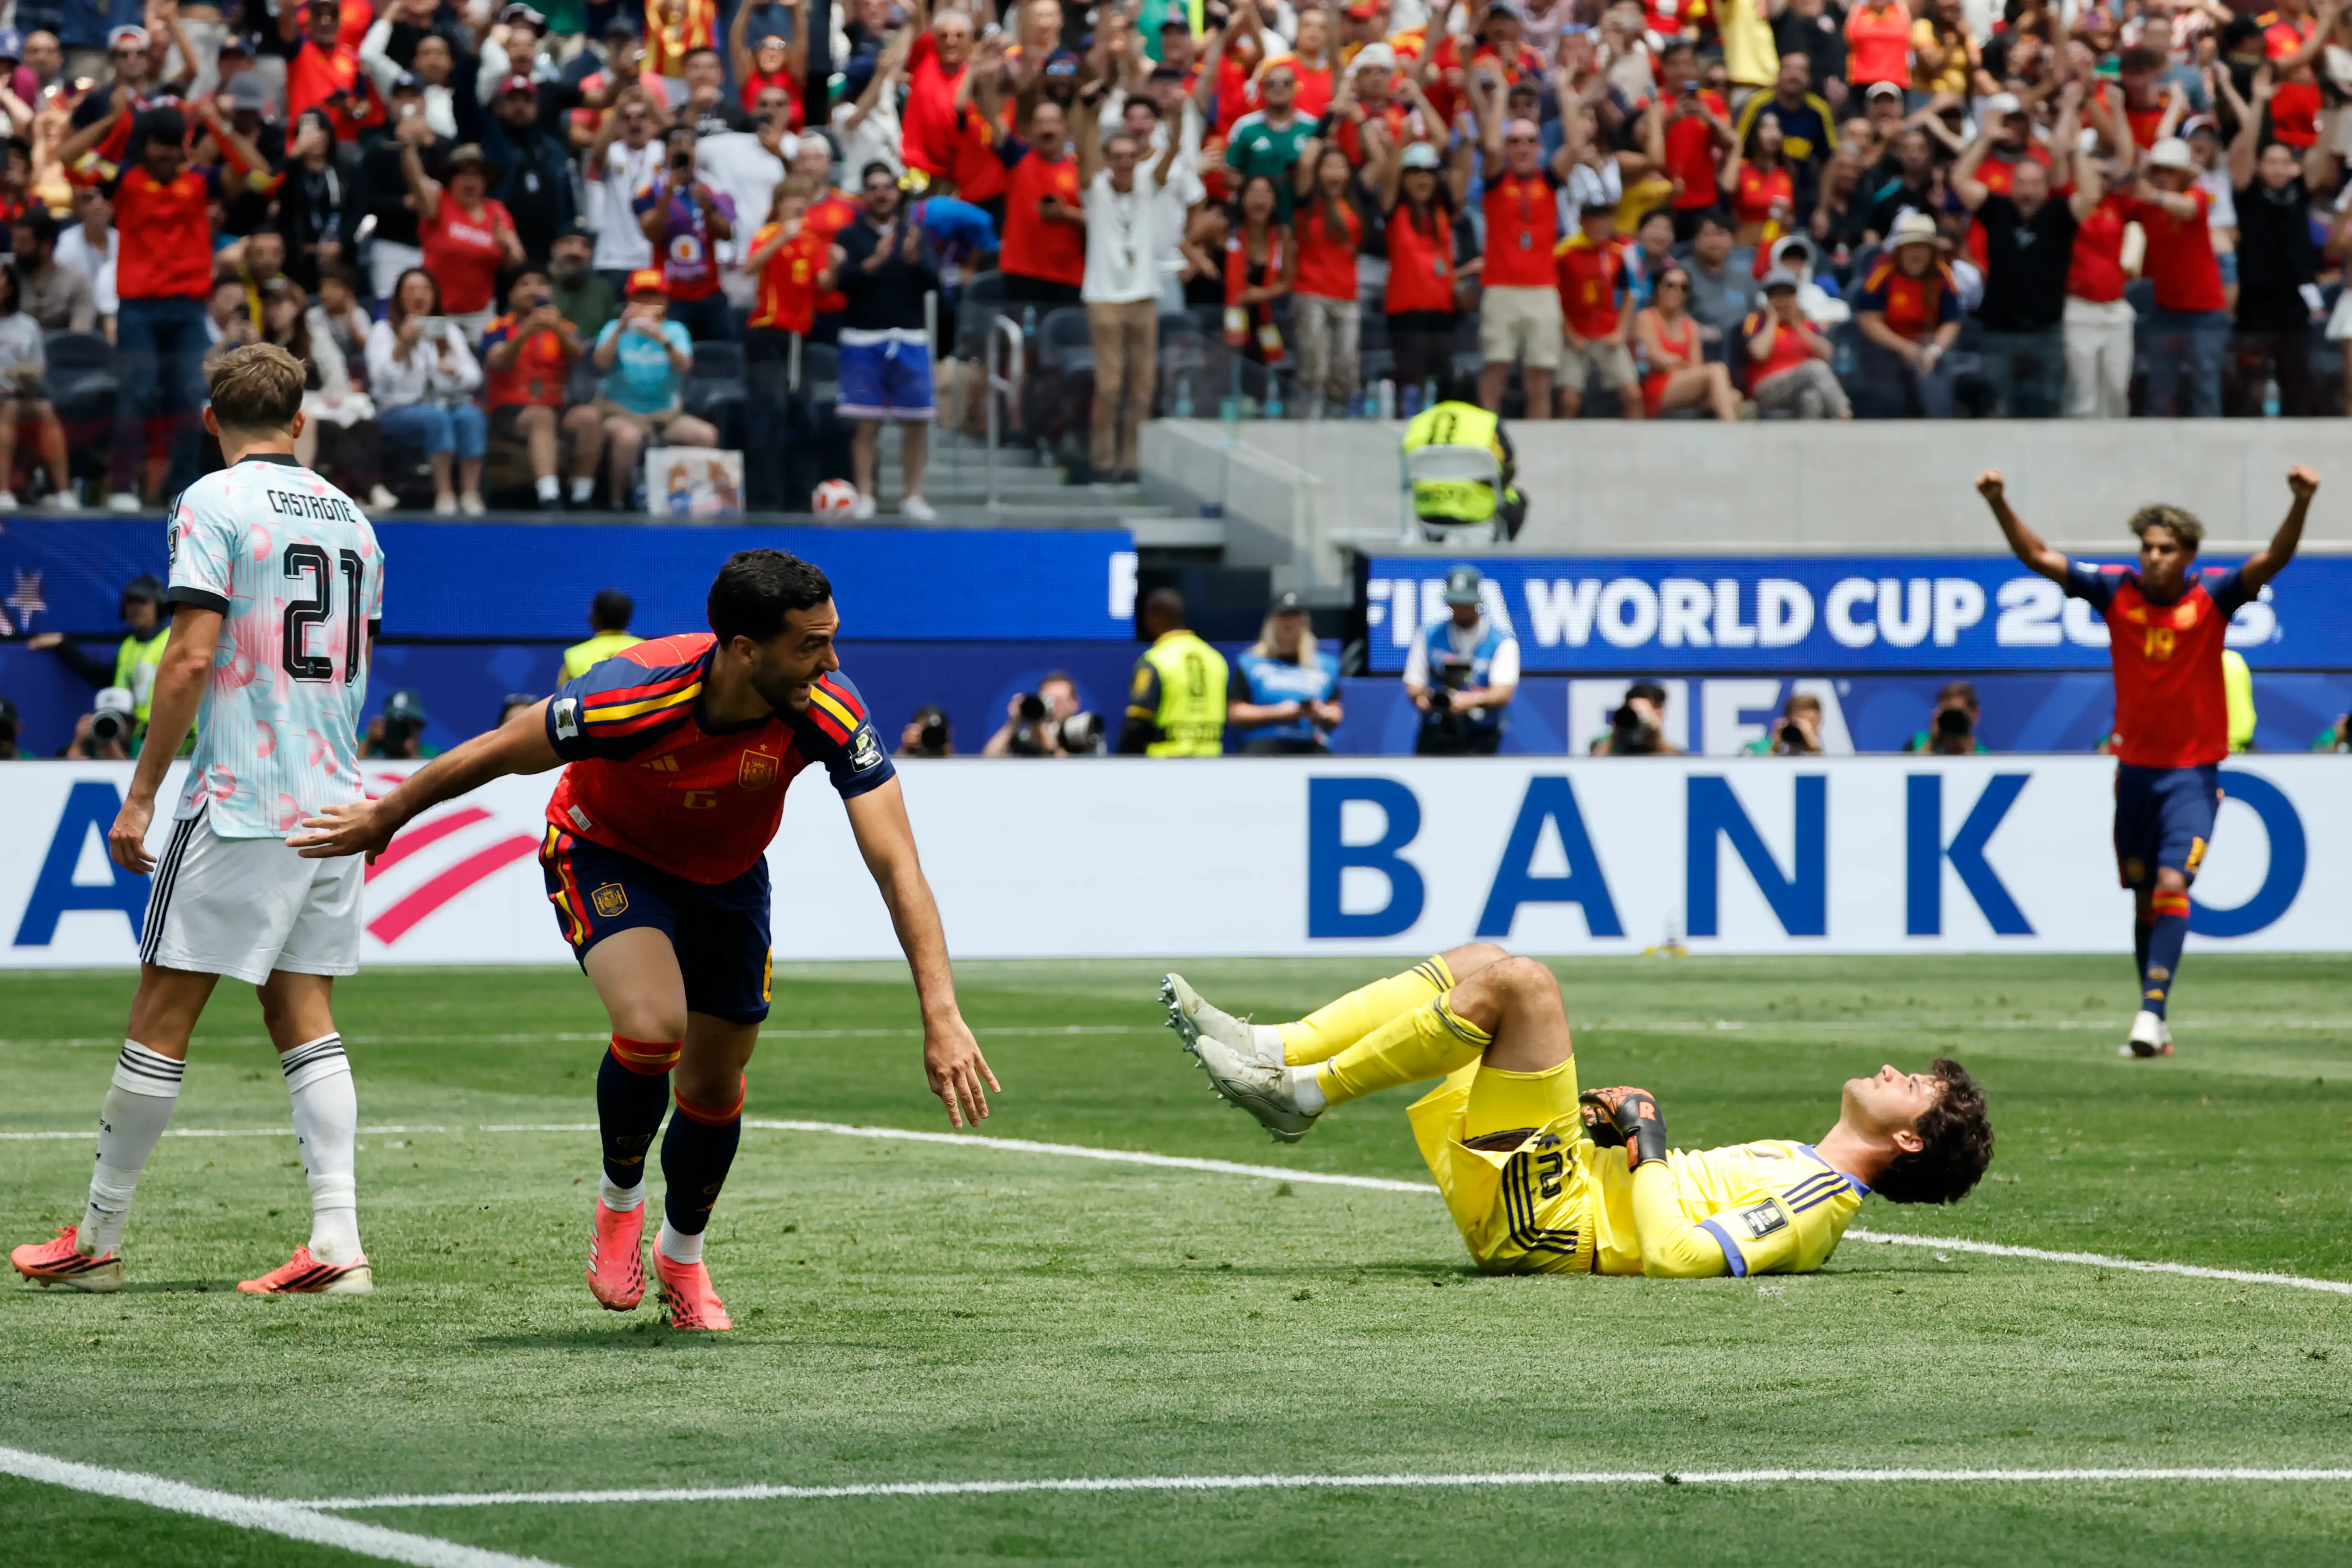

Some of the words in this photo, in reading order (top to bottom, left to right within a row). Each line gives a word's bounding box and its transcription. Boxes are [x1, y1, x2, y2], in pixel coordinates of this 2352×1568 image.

[267, 490, 357, 523] CASTAGNE
[283, 543, 365, 687] 21
[1525, 577, 1815, 648] WORLD
[1826, 577, 1986, 648] CUP
[2144, 626, 2175, 661] 19
[1308, 776, 2038, 940] BANK
